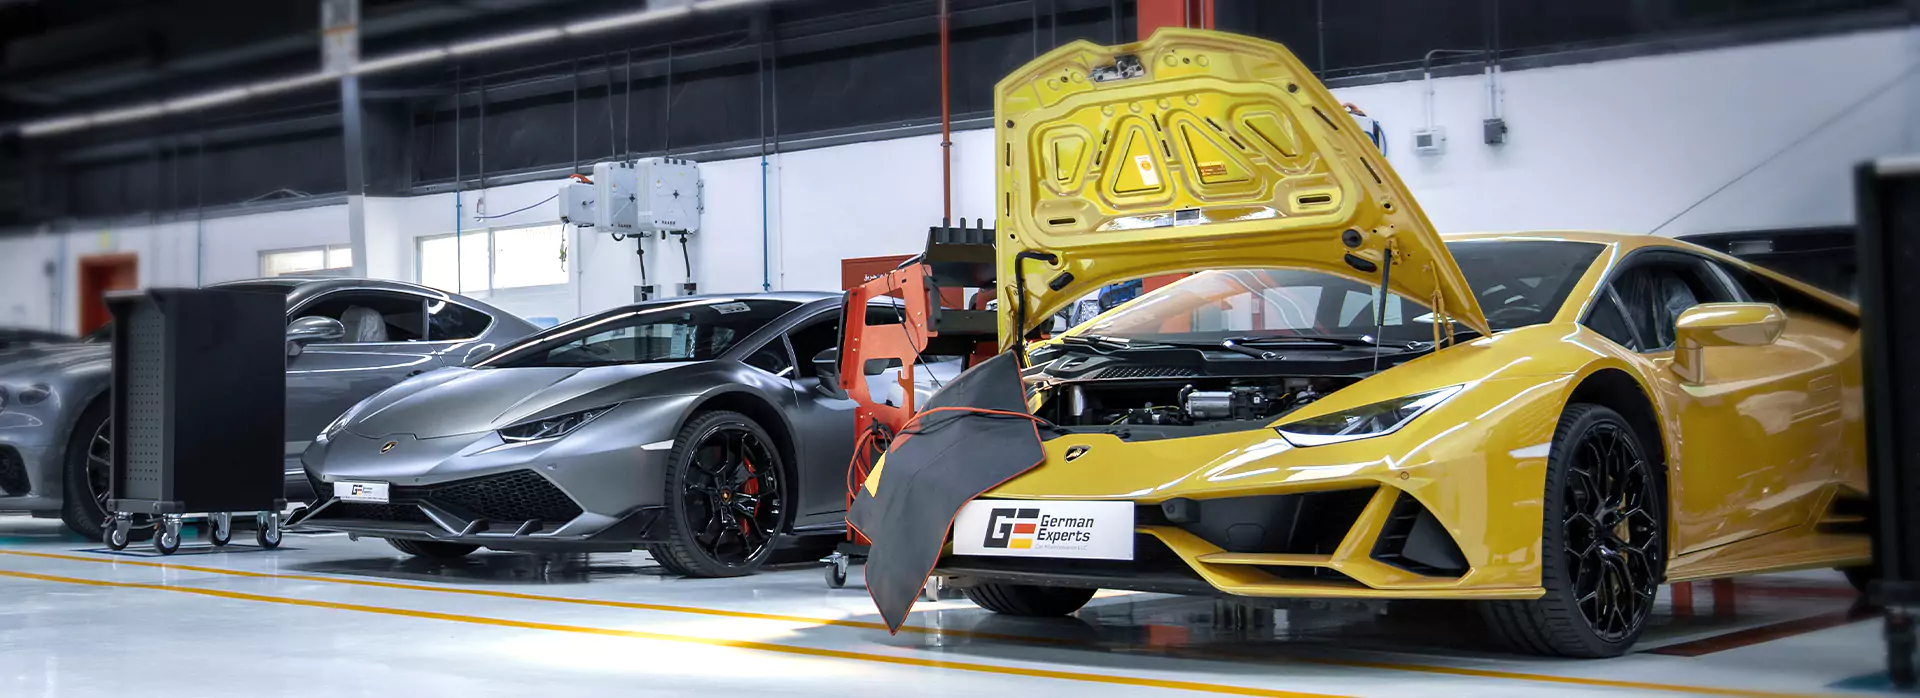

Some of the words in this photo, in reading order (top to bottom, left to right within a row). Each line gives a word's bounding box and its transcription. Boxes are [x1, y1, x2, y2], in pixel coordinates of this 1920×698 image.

[983, 508, 1040, 548] GE
[1040, 515, 1094, 528] German
[1037, 528, 1091, 543] Experts
